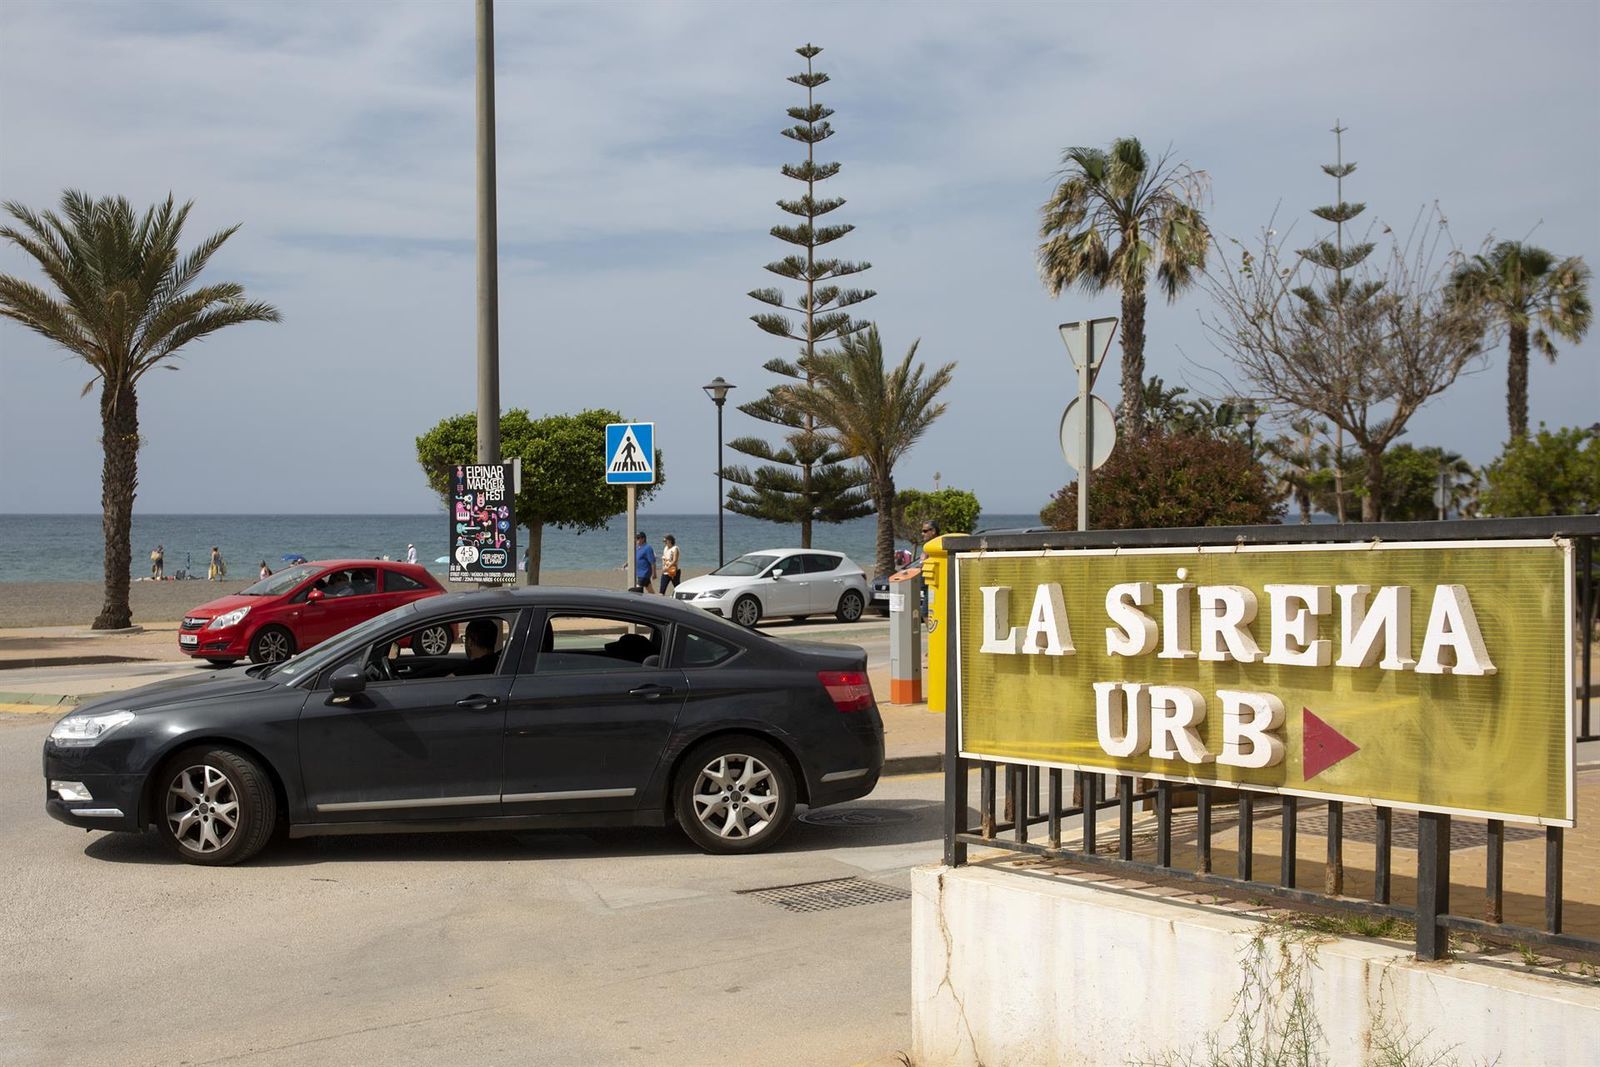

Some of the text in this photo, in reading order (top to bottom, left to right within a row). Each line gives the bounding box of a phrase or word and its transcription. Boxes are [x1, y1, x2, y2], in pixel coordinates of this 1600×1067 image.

[485, 488, 504, 501] FEST
[460, 547, 473, 556] 4-5
[980, 582, 1076, 656] LA
[1093, 681, 1287, 770] URB
